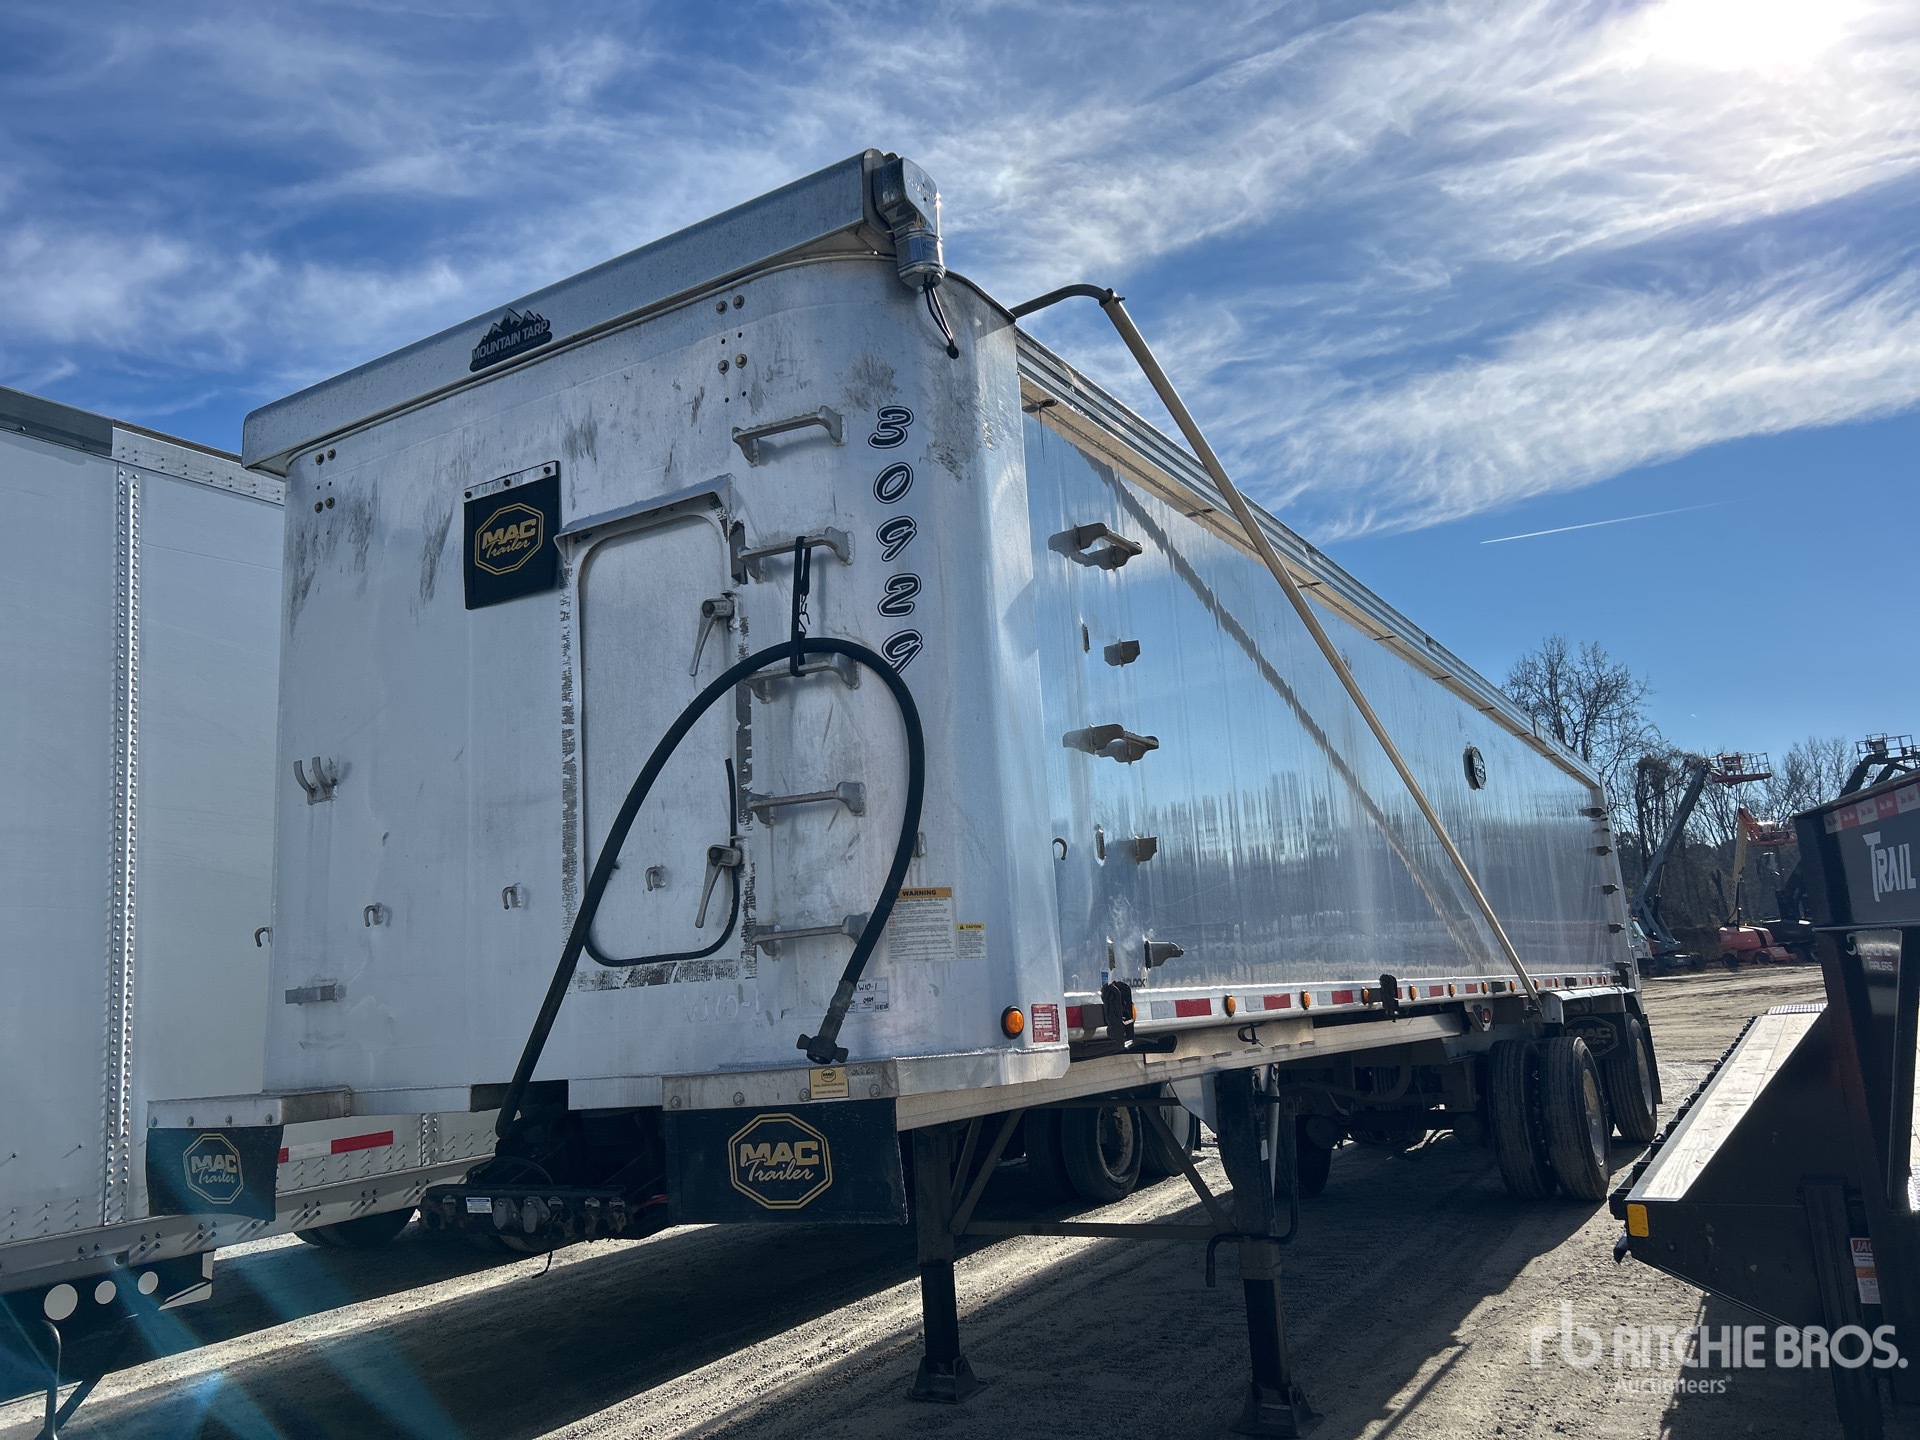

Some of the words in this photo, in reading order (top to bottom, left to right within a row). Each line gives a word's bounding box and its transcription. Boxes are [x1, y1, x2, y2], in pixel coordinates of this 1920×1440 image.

[472, 331, 520, 361] MOUNTAIN
[522, 321, 548, 340] TARP
[481, 518, 537, 550] MAC
[868, 405, 923, 675] 30929
[486, 536, 531, 559] Trailer
[1862, 831, 1917, 902] TRAIL
[902, 889, 937, 897] WARNING
[191, 1154, 237, 1174] MAC
[739, 1140, 820, 1168] MAC
[195, 1167, 236, 1184] Trailer
[745, 1158, 815, 1182] Trailer
